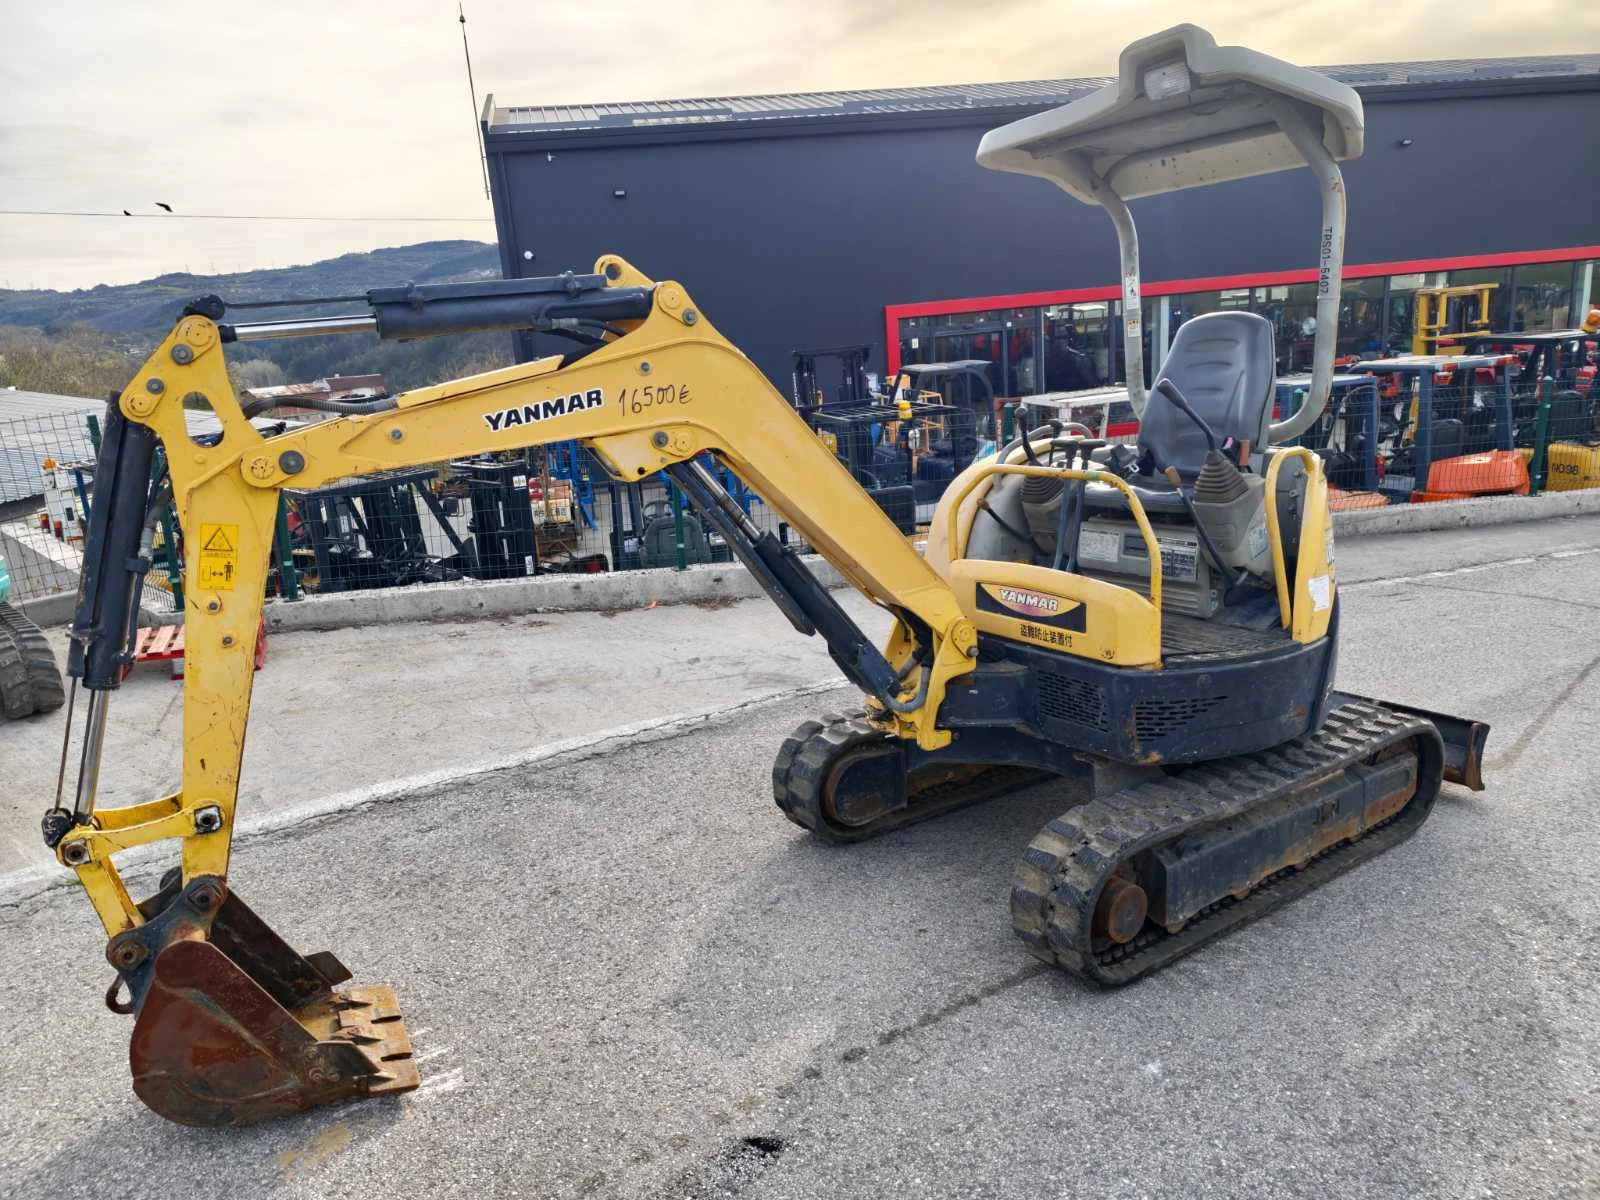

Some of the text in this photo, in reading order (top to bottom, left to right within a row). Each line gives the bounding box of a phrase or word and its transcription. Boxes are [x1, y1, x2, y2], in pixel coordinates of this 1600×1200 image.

[484, 389, 603, 431] YANMAR
[619, 384, 693, 416] 16500€
[1000, 588, 1058, 611] YANMAR
